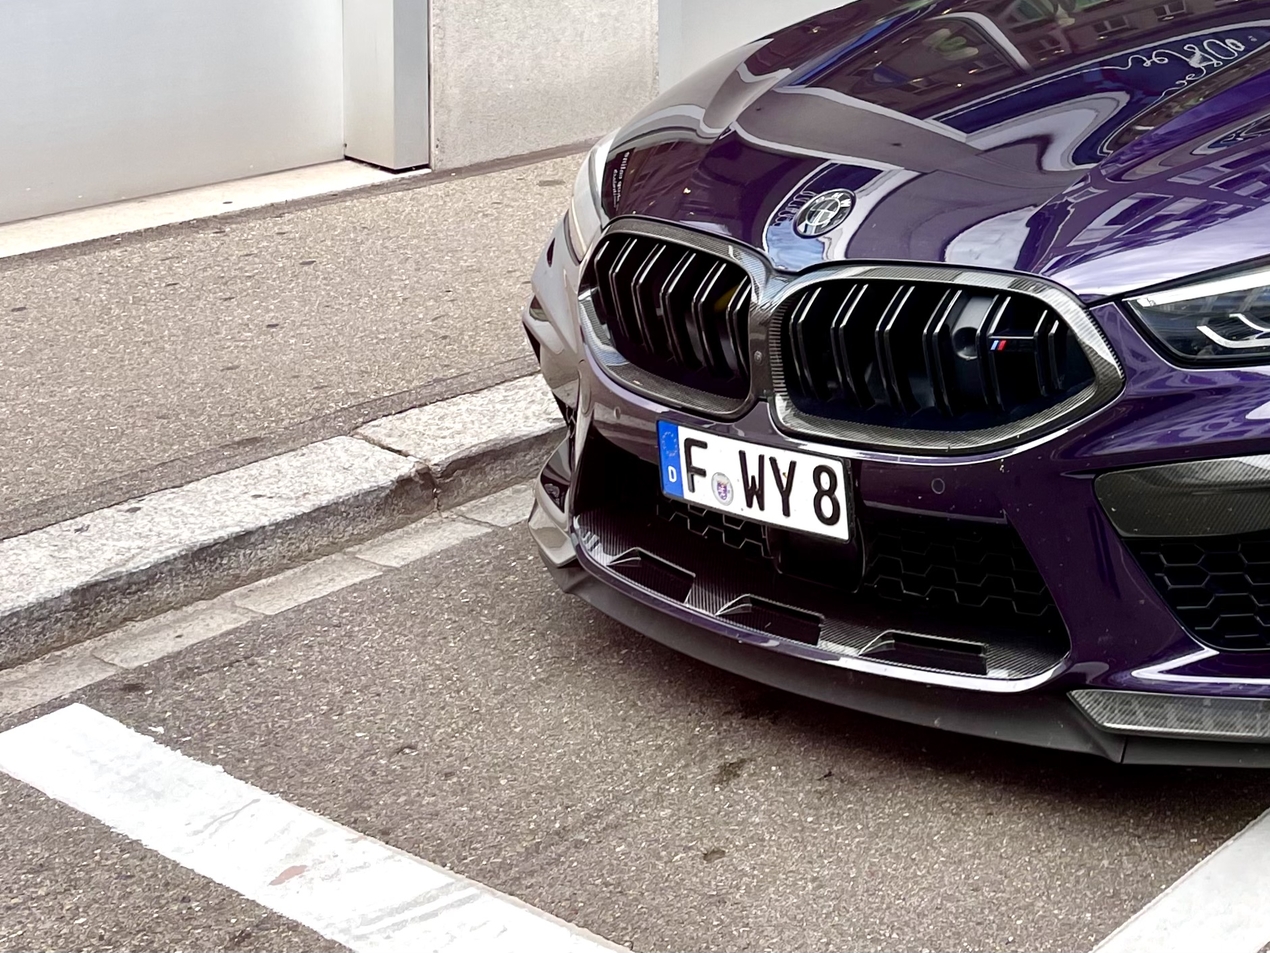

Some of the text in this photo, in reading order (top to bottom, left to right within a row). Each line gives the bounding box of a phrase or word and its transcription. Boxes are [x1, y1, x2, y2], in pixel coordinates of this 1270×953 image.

[667, 465, 677, 483] D
[684, 437, 841, 527] F WY 8
